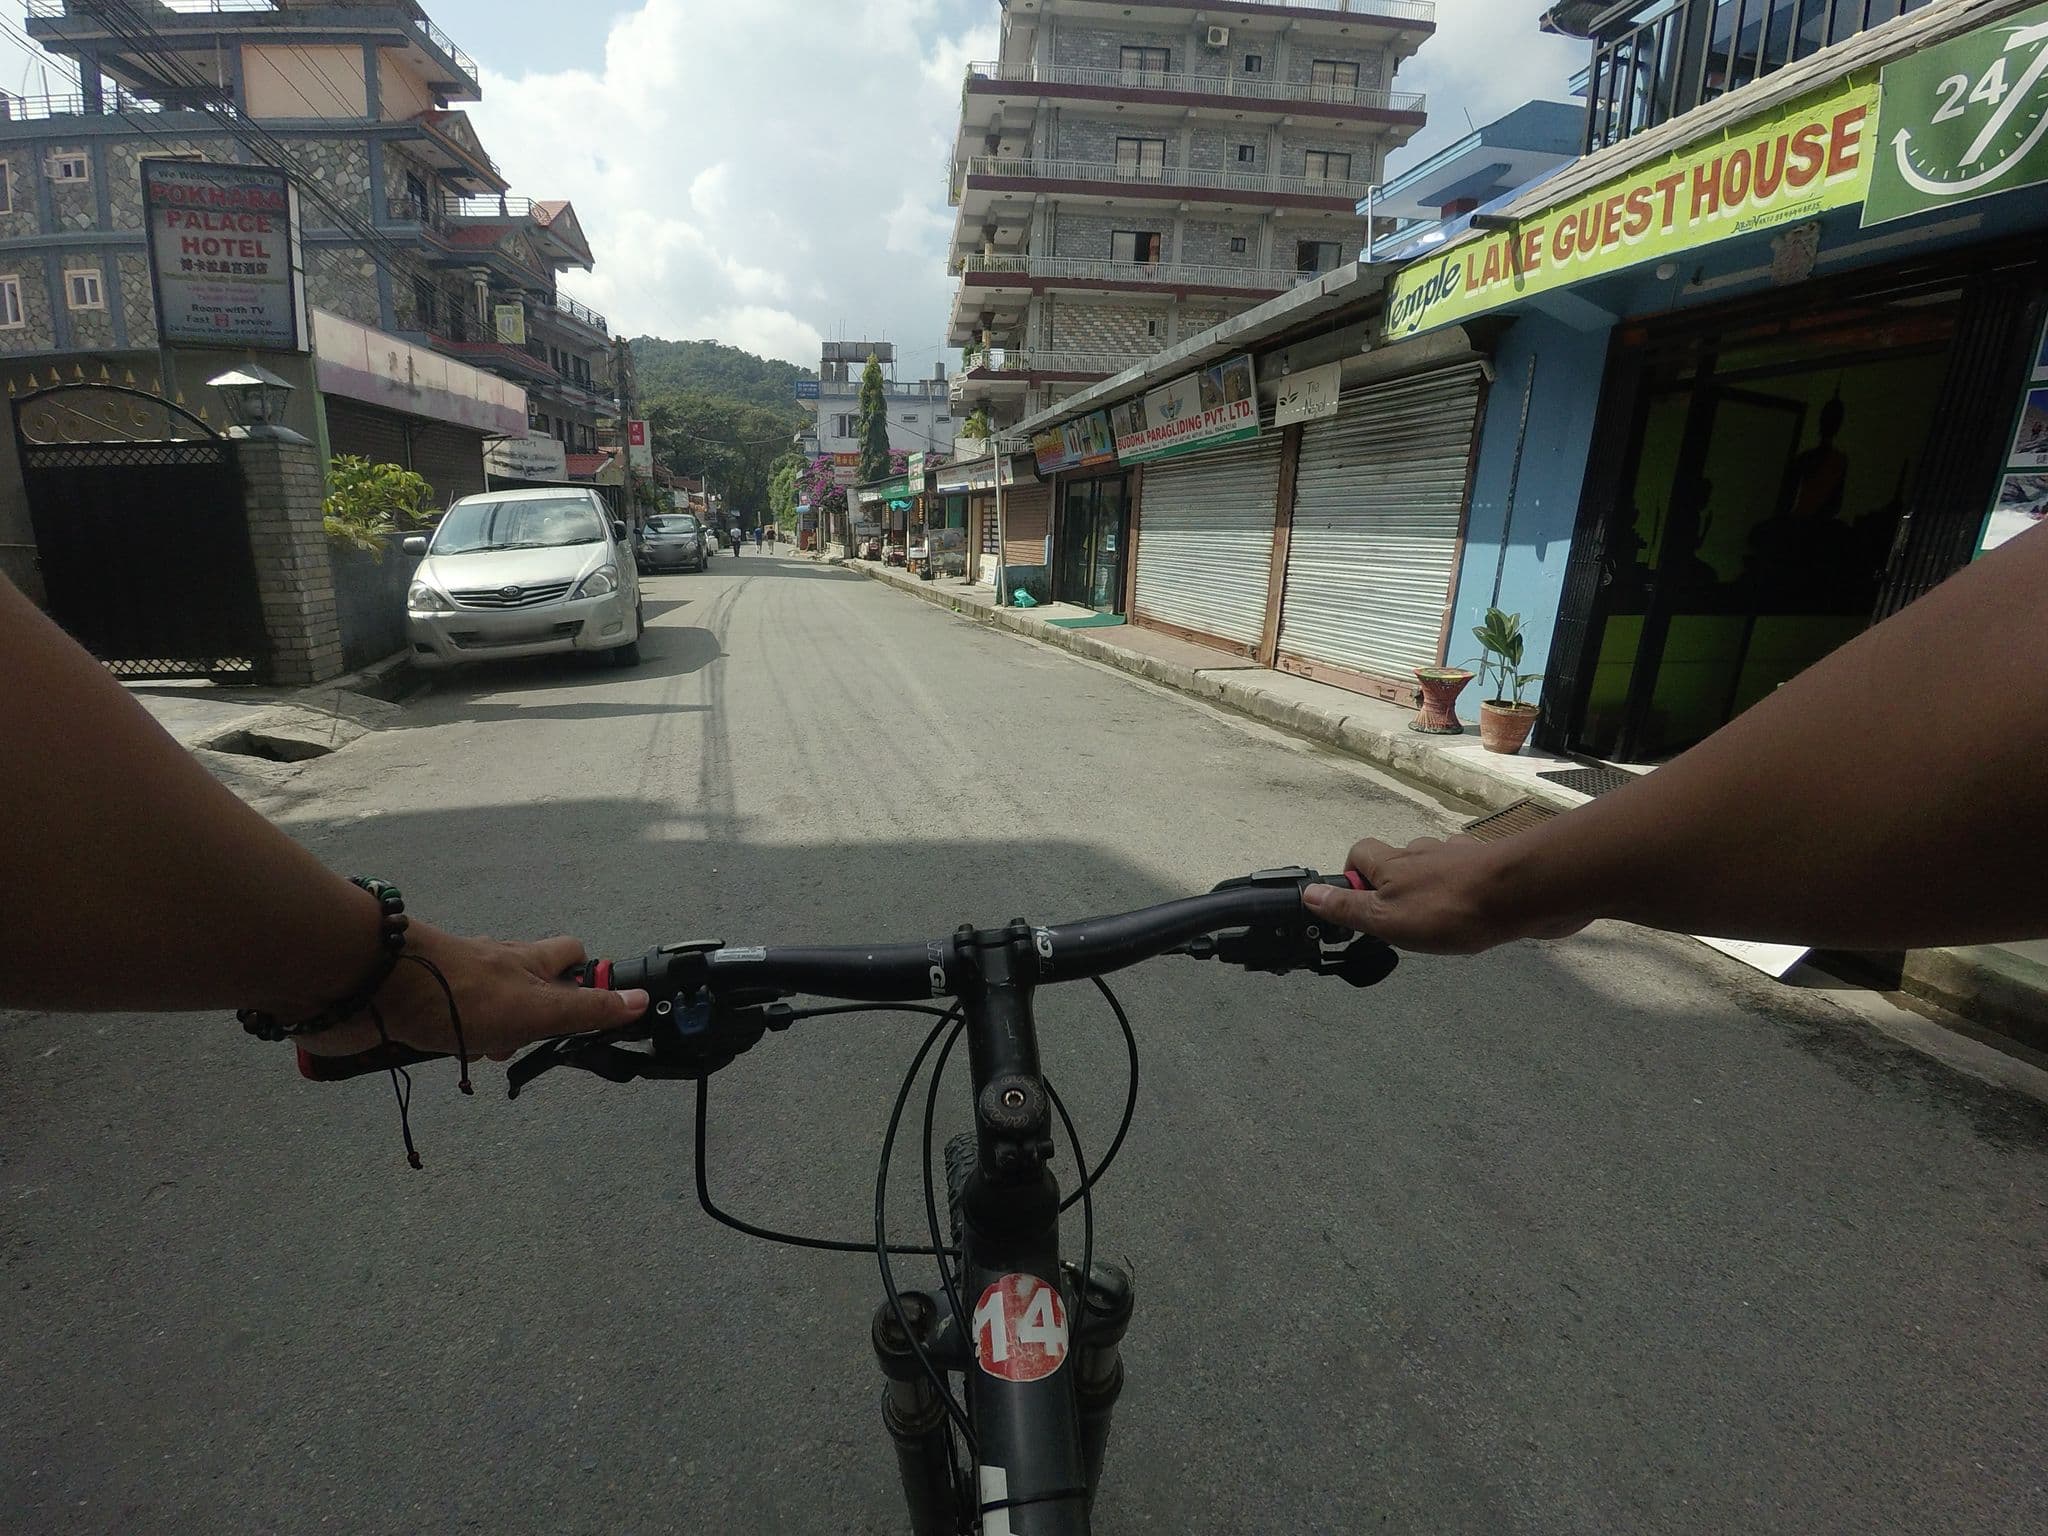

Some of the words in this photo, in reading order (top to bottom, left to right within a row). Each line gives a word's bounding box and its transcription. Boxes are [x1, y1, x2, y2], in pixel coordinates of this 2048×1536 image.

[1930, 58, 2008, 124] 24
[151, 182, 285, 209] POKHARA
[1465, 226, 1546, 293] LAKE
[1552, 172, 1685, 262] GUEST
[1689, 105, 1868, 221] HOUSE
[166, 209, 272, 233] PALACE
[181, 236, 271, 258] HOTEL
[186, 314, 209, 323] Fast
[235, 318, 273, 327] service
[191, 303, 222, 313] Room
[225, 305, 247, 314] with
[250, 306, 265, 314] TV
[1117, 434, 1145, 450] BUDDHA
[1146, 415, 1202, 443] PARAGLIDING
[1204, 407, 1226, 427] PVT.
[1229, 400, 1254, 420] LTD.
[974, 1287, 1064, 1363] 14
